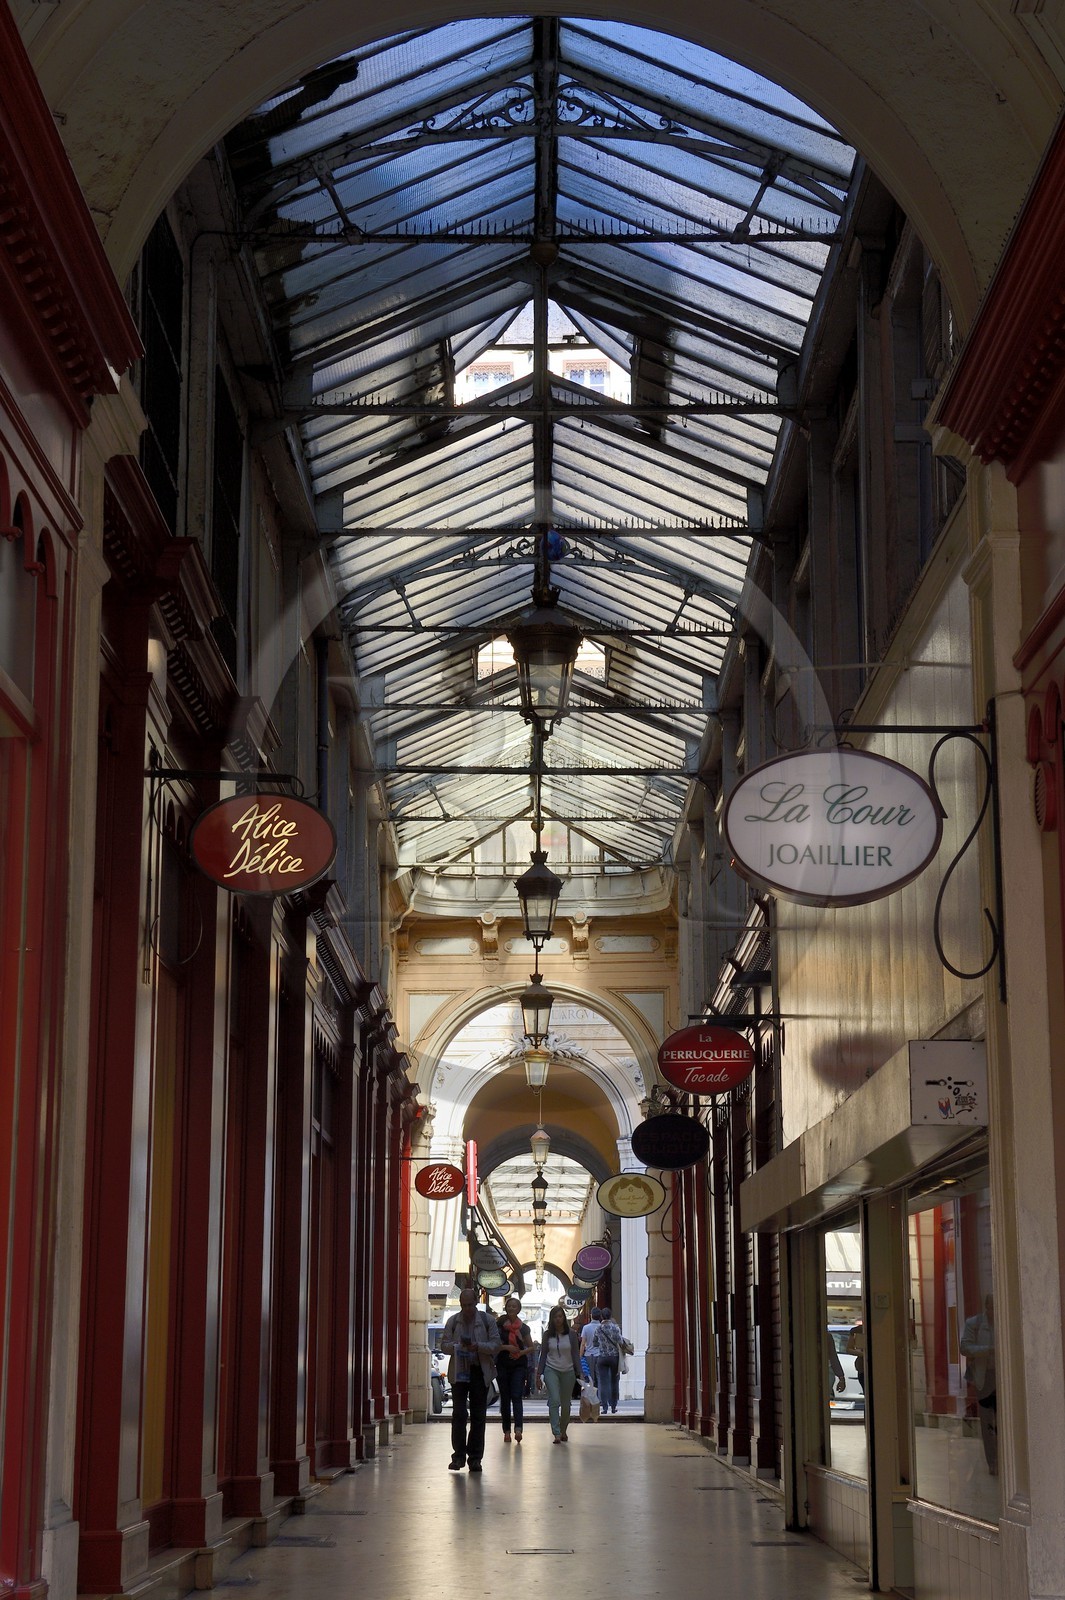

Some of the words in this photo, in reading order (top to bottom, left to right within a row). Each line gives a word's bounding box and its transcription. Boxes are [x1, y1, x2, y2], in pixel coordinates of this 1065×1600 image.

[744, 781, 811, 823] La
[822, 783, 916, 826] Cour
[231, 803, 299, 840] Alice
[223, 838, 305, 878] Délice
[767, 843, 893, 867] JOAILLIER
[699, 1033, 713, 1043] La
[663, 1049, 750, 1061] PERRUQUERIE
[683, 1066, 730, 1084] Tocade
[428, 1167, 453, 1181] Alice
[426, 1180, 455, 1195] Délice
